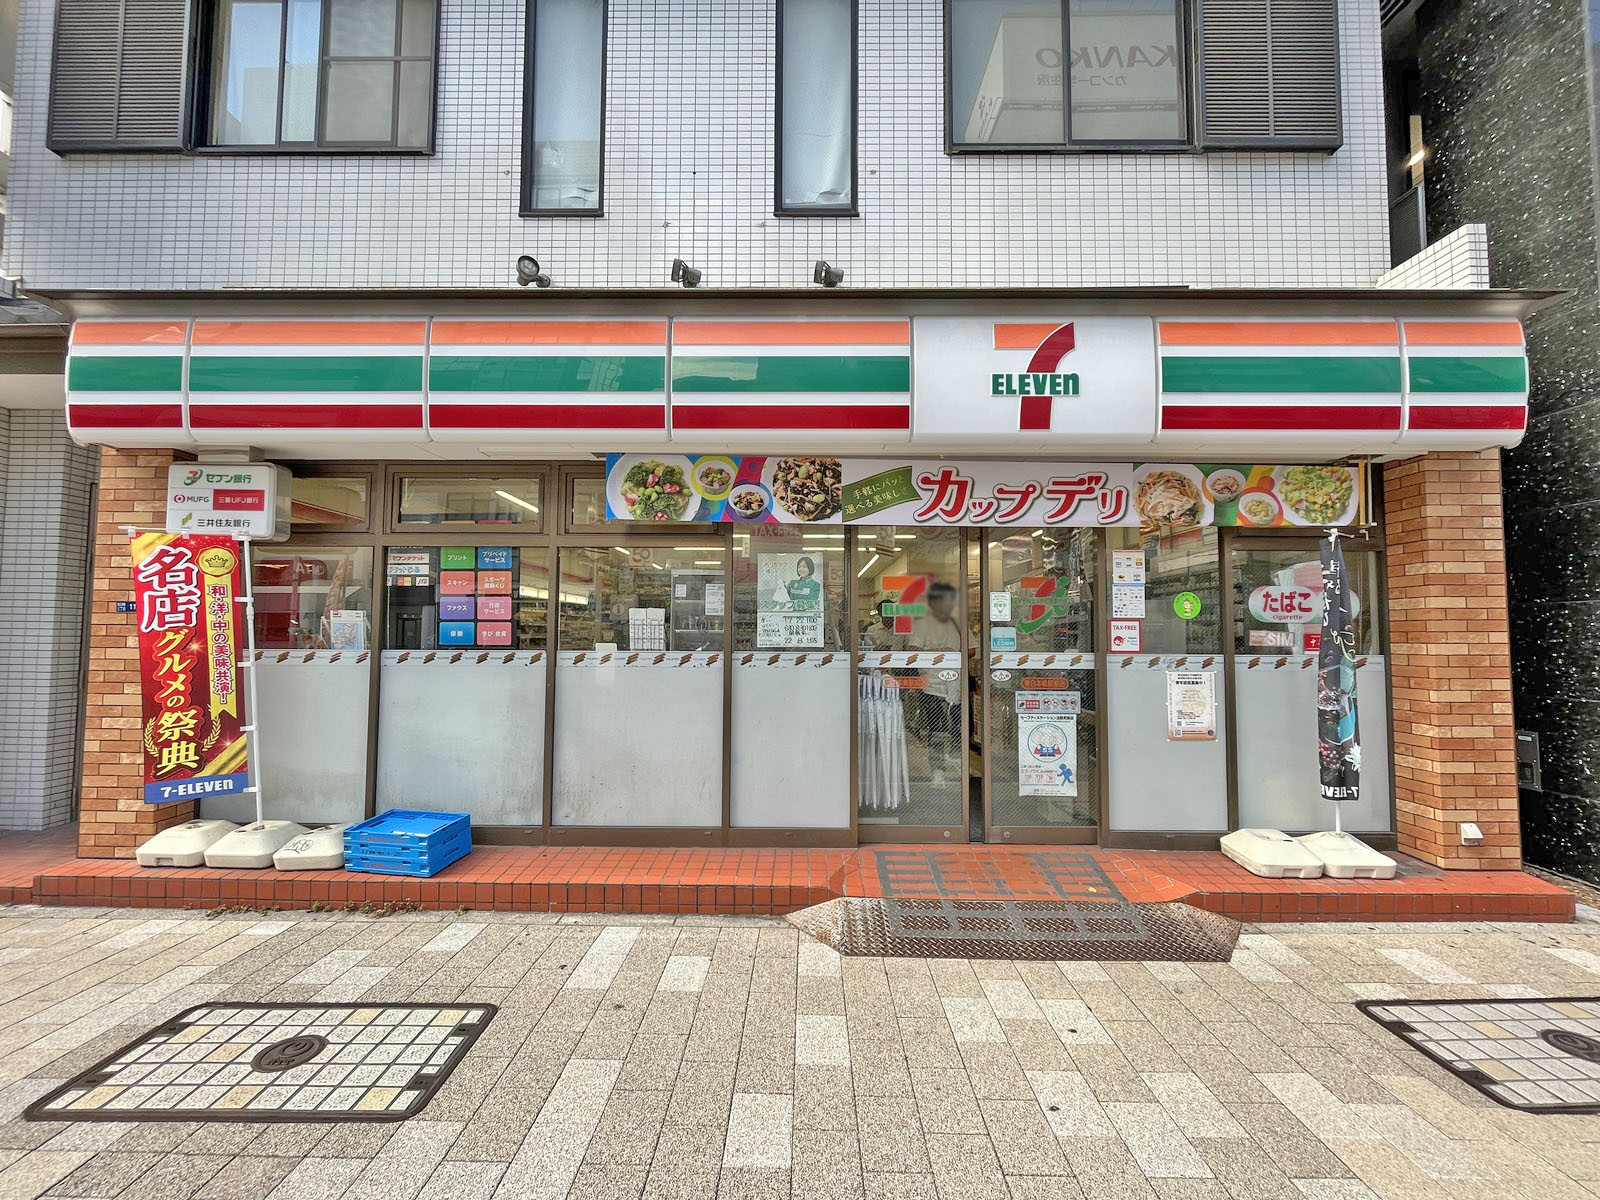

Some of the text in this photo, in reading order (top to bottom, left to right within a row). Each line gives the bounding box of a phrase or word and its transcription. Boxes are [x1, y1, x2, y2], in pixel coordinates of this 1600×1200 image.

[206, 474, 252, 484] セブン銀行
[917, 465, 1127, 524] カップデリ
[197, 518, 251, 527] 三井住友銀行
[1263, 592, 1313, 614] たばこ
